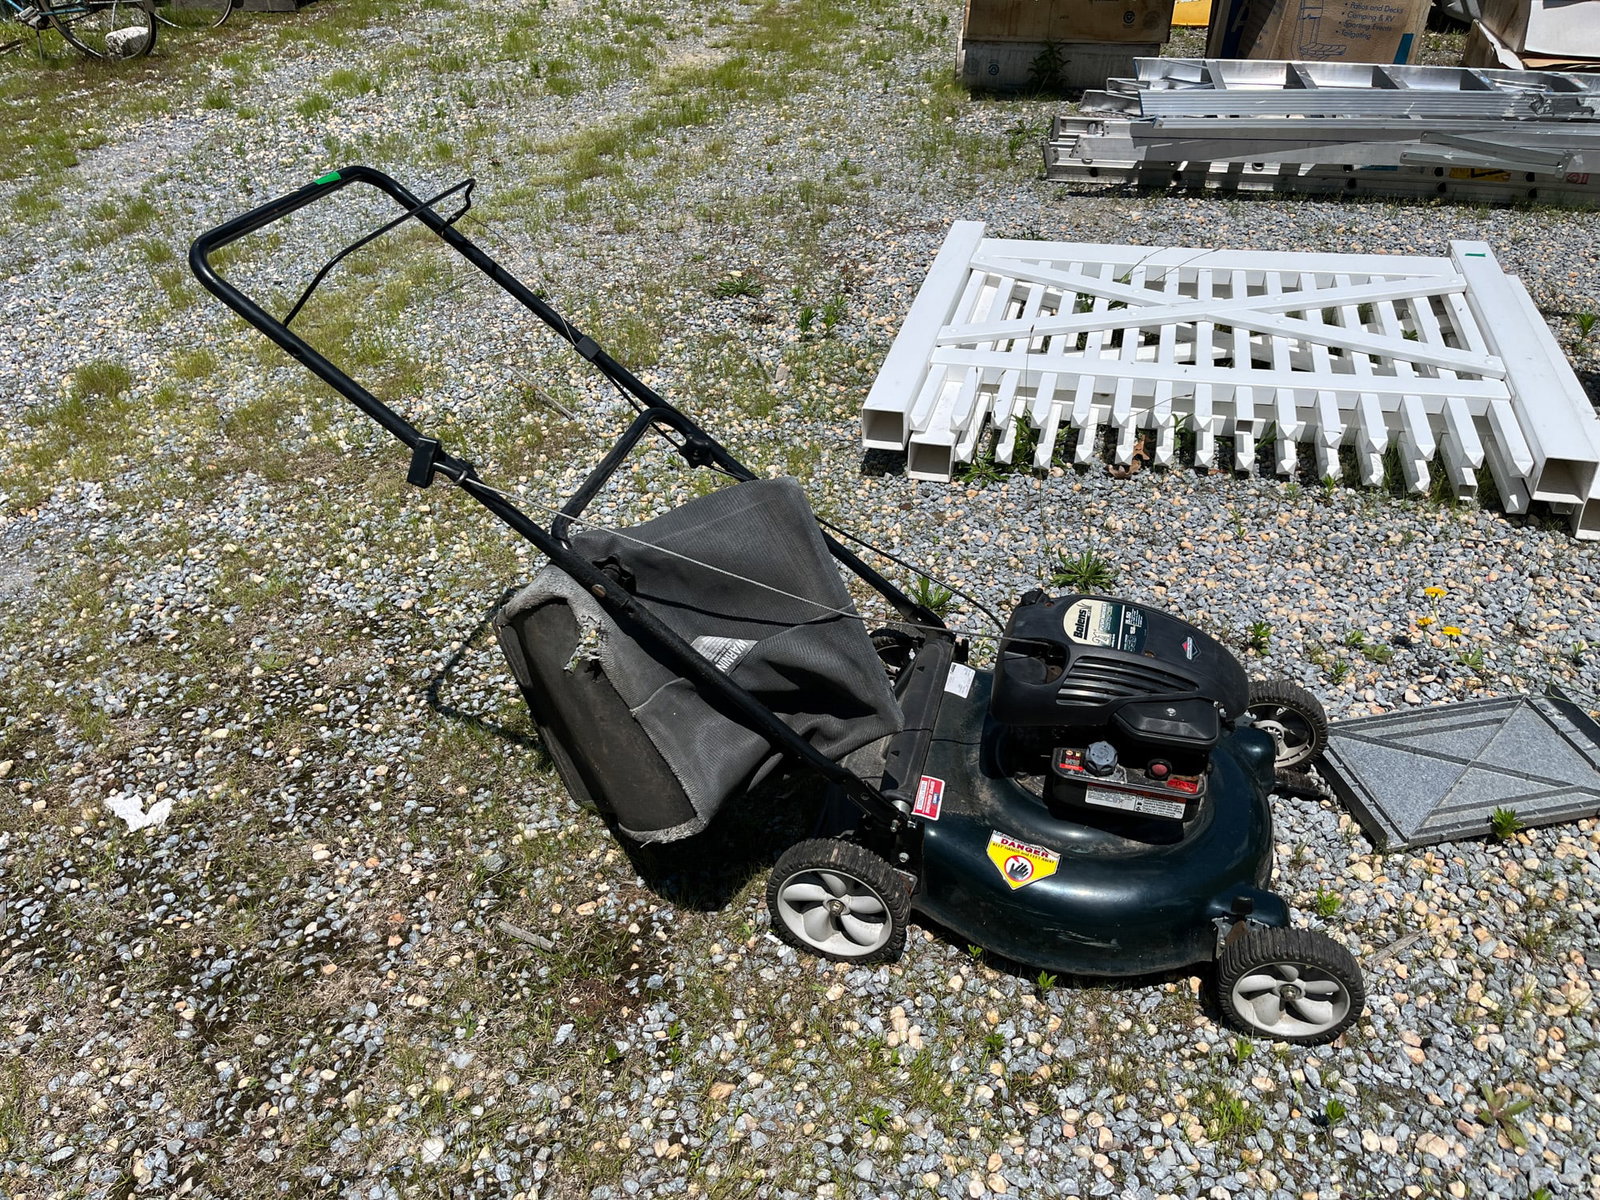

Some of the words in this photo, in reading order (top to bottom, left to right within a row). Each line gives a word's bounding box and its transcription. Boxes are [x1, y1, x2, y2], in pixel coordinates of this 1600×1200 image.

[1350, 2, 1369, 10] Patios
[1384, 5, 1404, 14] Decks
[1347, 11, 1377, 22] Camping
[1343, 20, 1371, 31] Sporting
[1371, 23, 1393, 32] Events
[1341, 29, 1372, 40] Tailgating
[1073, 608, 1087, 639] Bolens
[715, 638, 748, 673] WARNIN
[1000, 838, 1050, 858] DANGER
